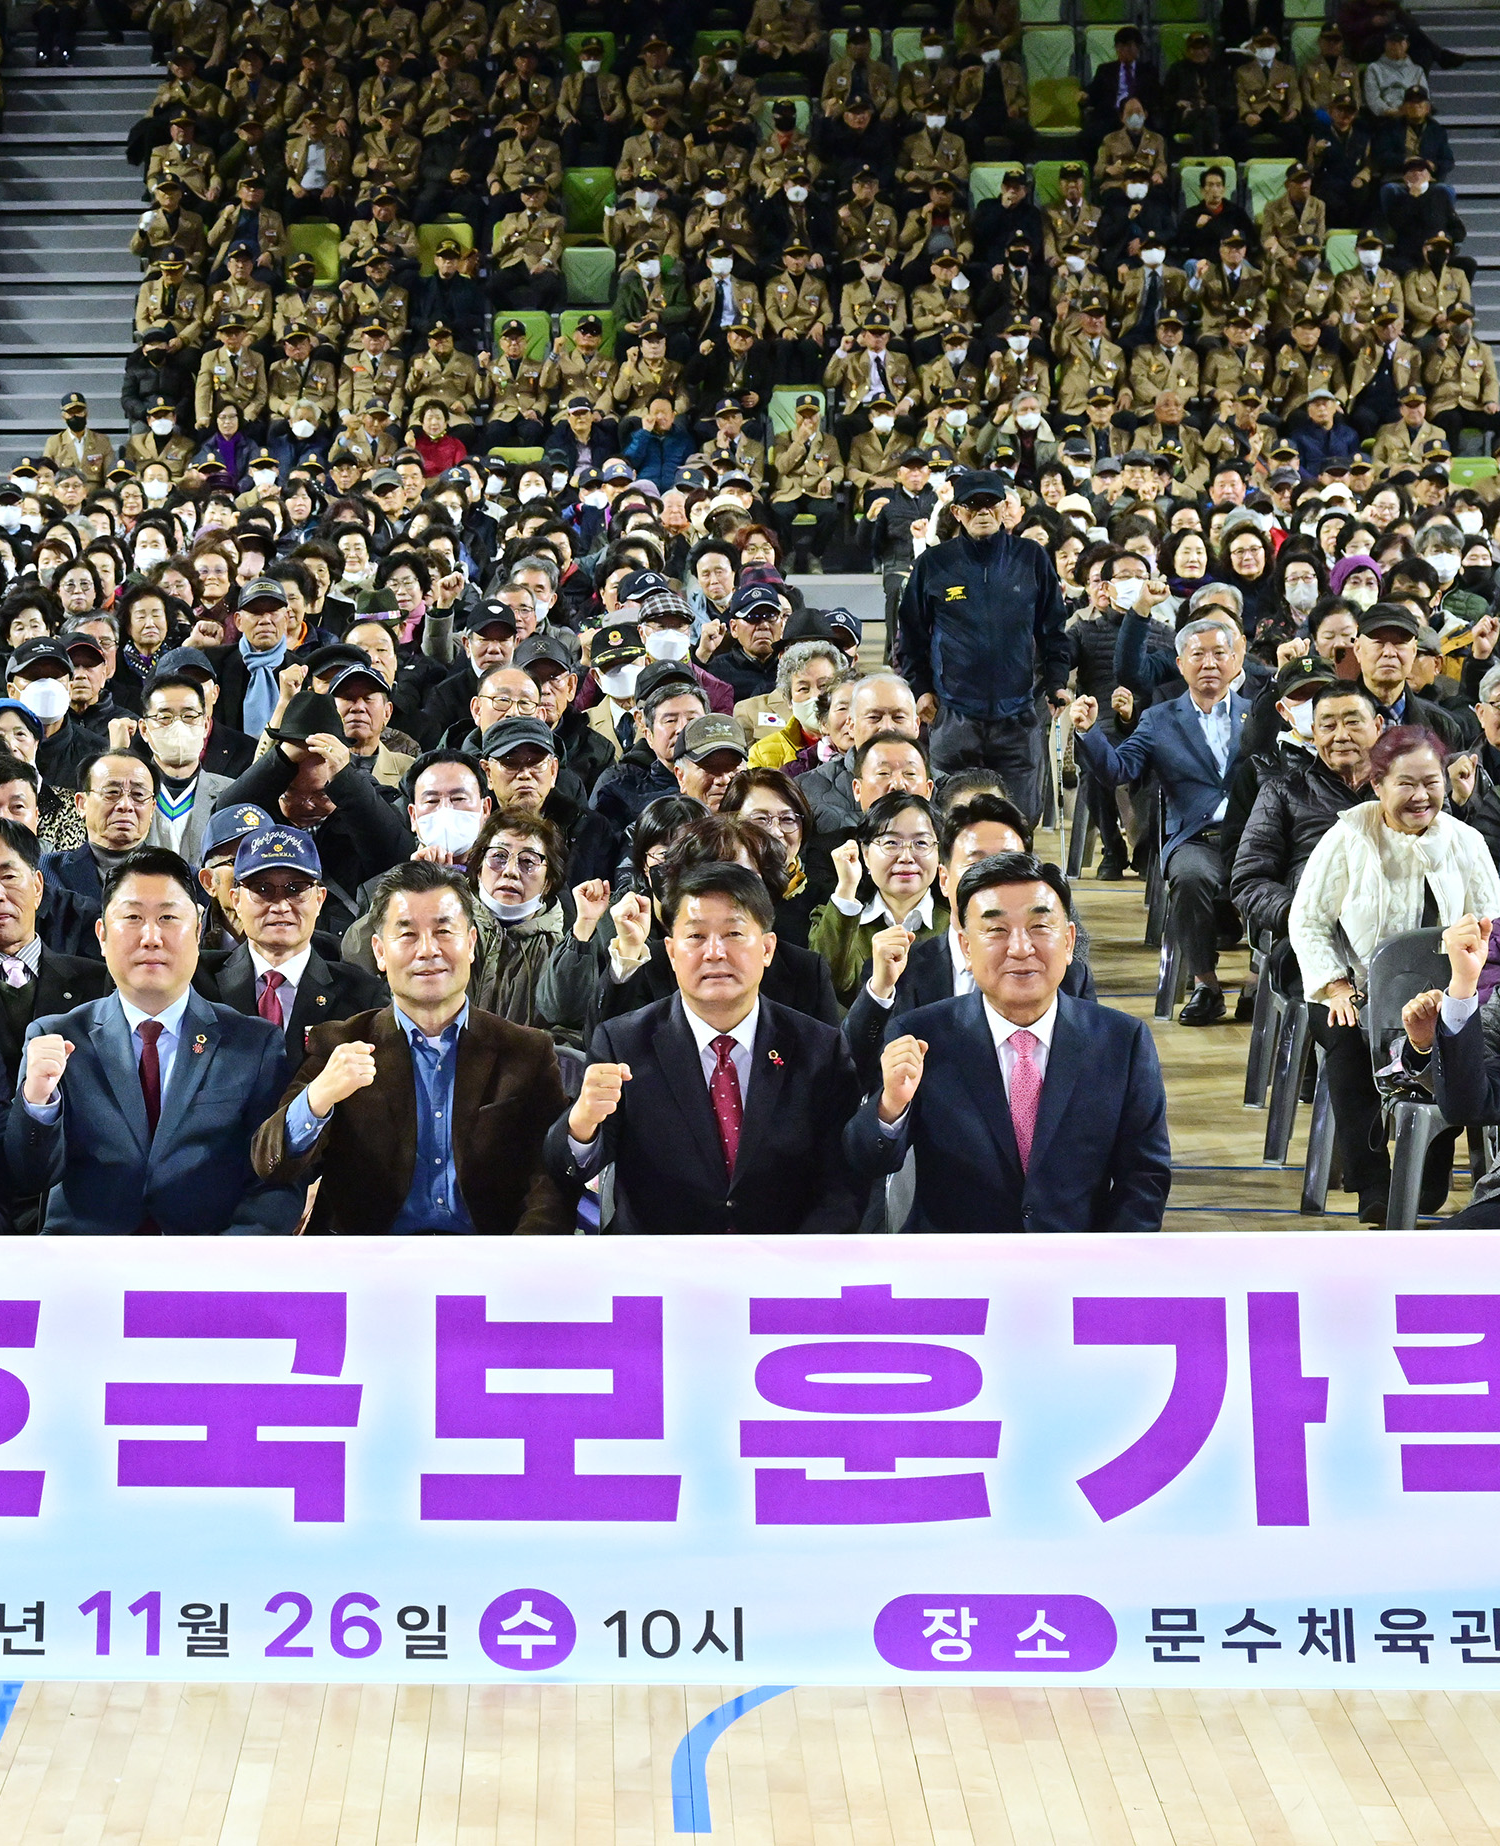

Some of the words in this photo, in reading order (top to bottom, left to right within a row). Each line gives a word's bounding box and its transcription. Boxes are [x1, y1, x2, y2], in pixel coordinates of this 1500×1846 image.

[78, 1591, 229, 1657] 11월
[265, 1592, 447, 1660] 26일
[498, 1600, 556, 1660] 수
[604, 1607, 743, 1661] 10시
[1145, 1608, 1500, 1664] 문수체육관
